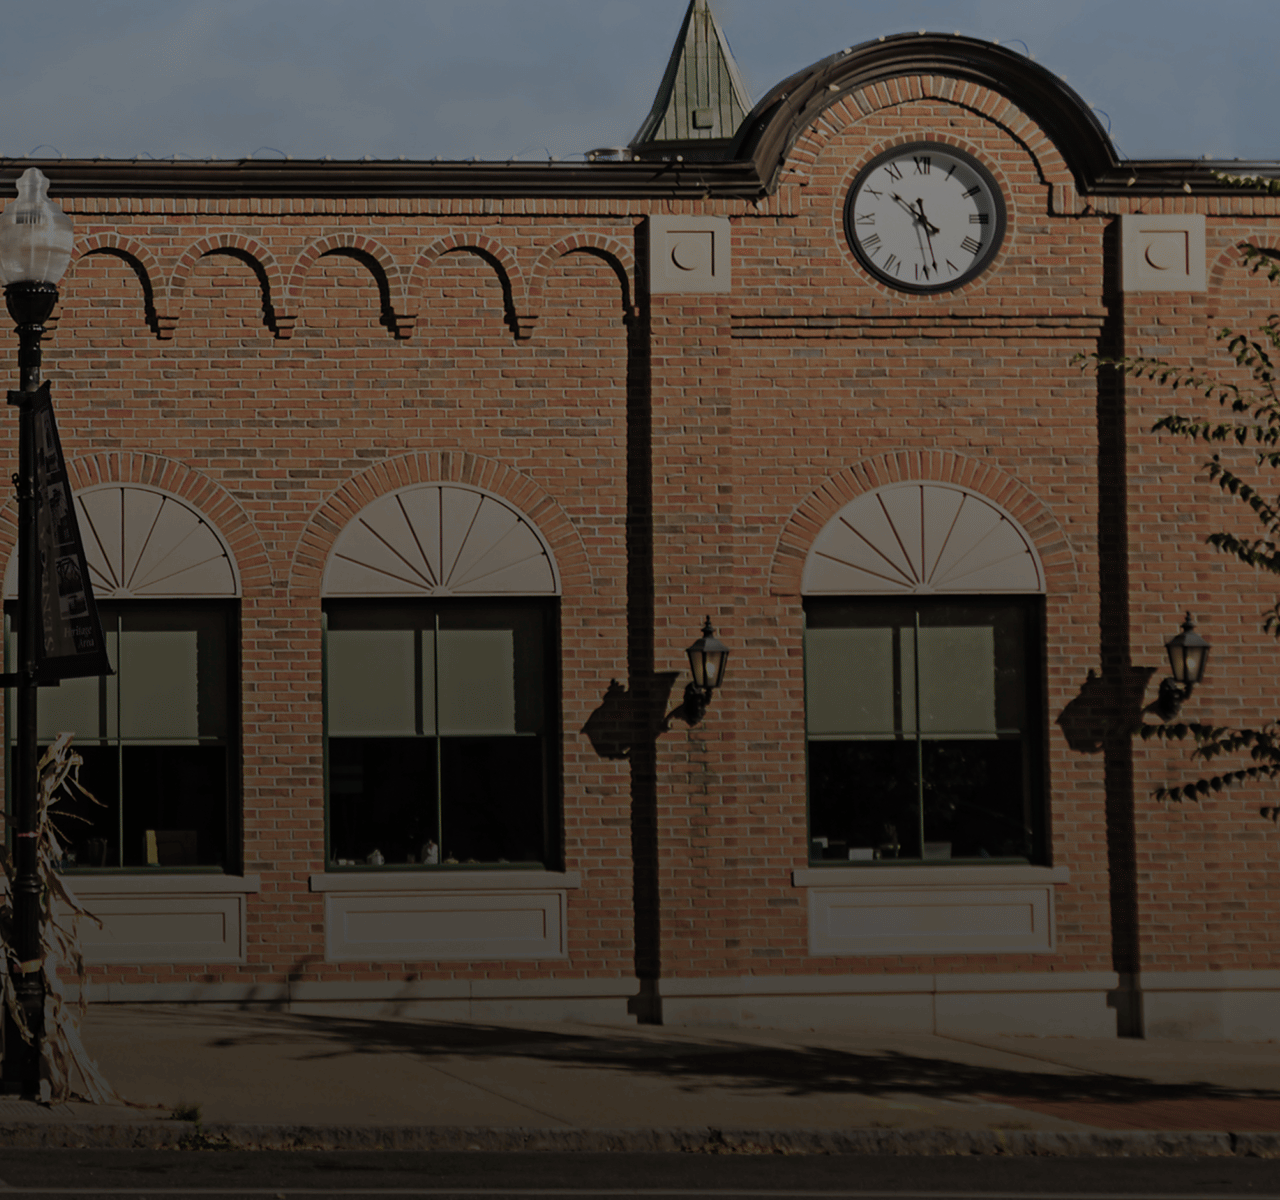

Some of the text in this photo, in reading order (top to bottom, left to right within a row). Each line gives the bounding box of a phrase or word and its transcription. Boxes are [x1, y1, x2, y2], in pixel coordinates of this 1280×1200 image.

[913, 157, 930, 174] XII
[864, 184, 883, 201] X
[64, 626, 92, 638] Heritage
[78, 638, 95, 649] Area
